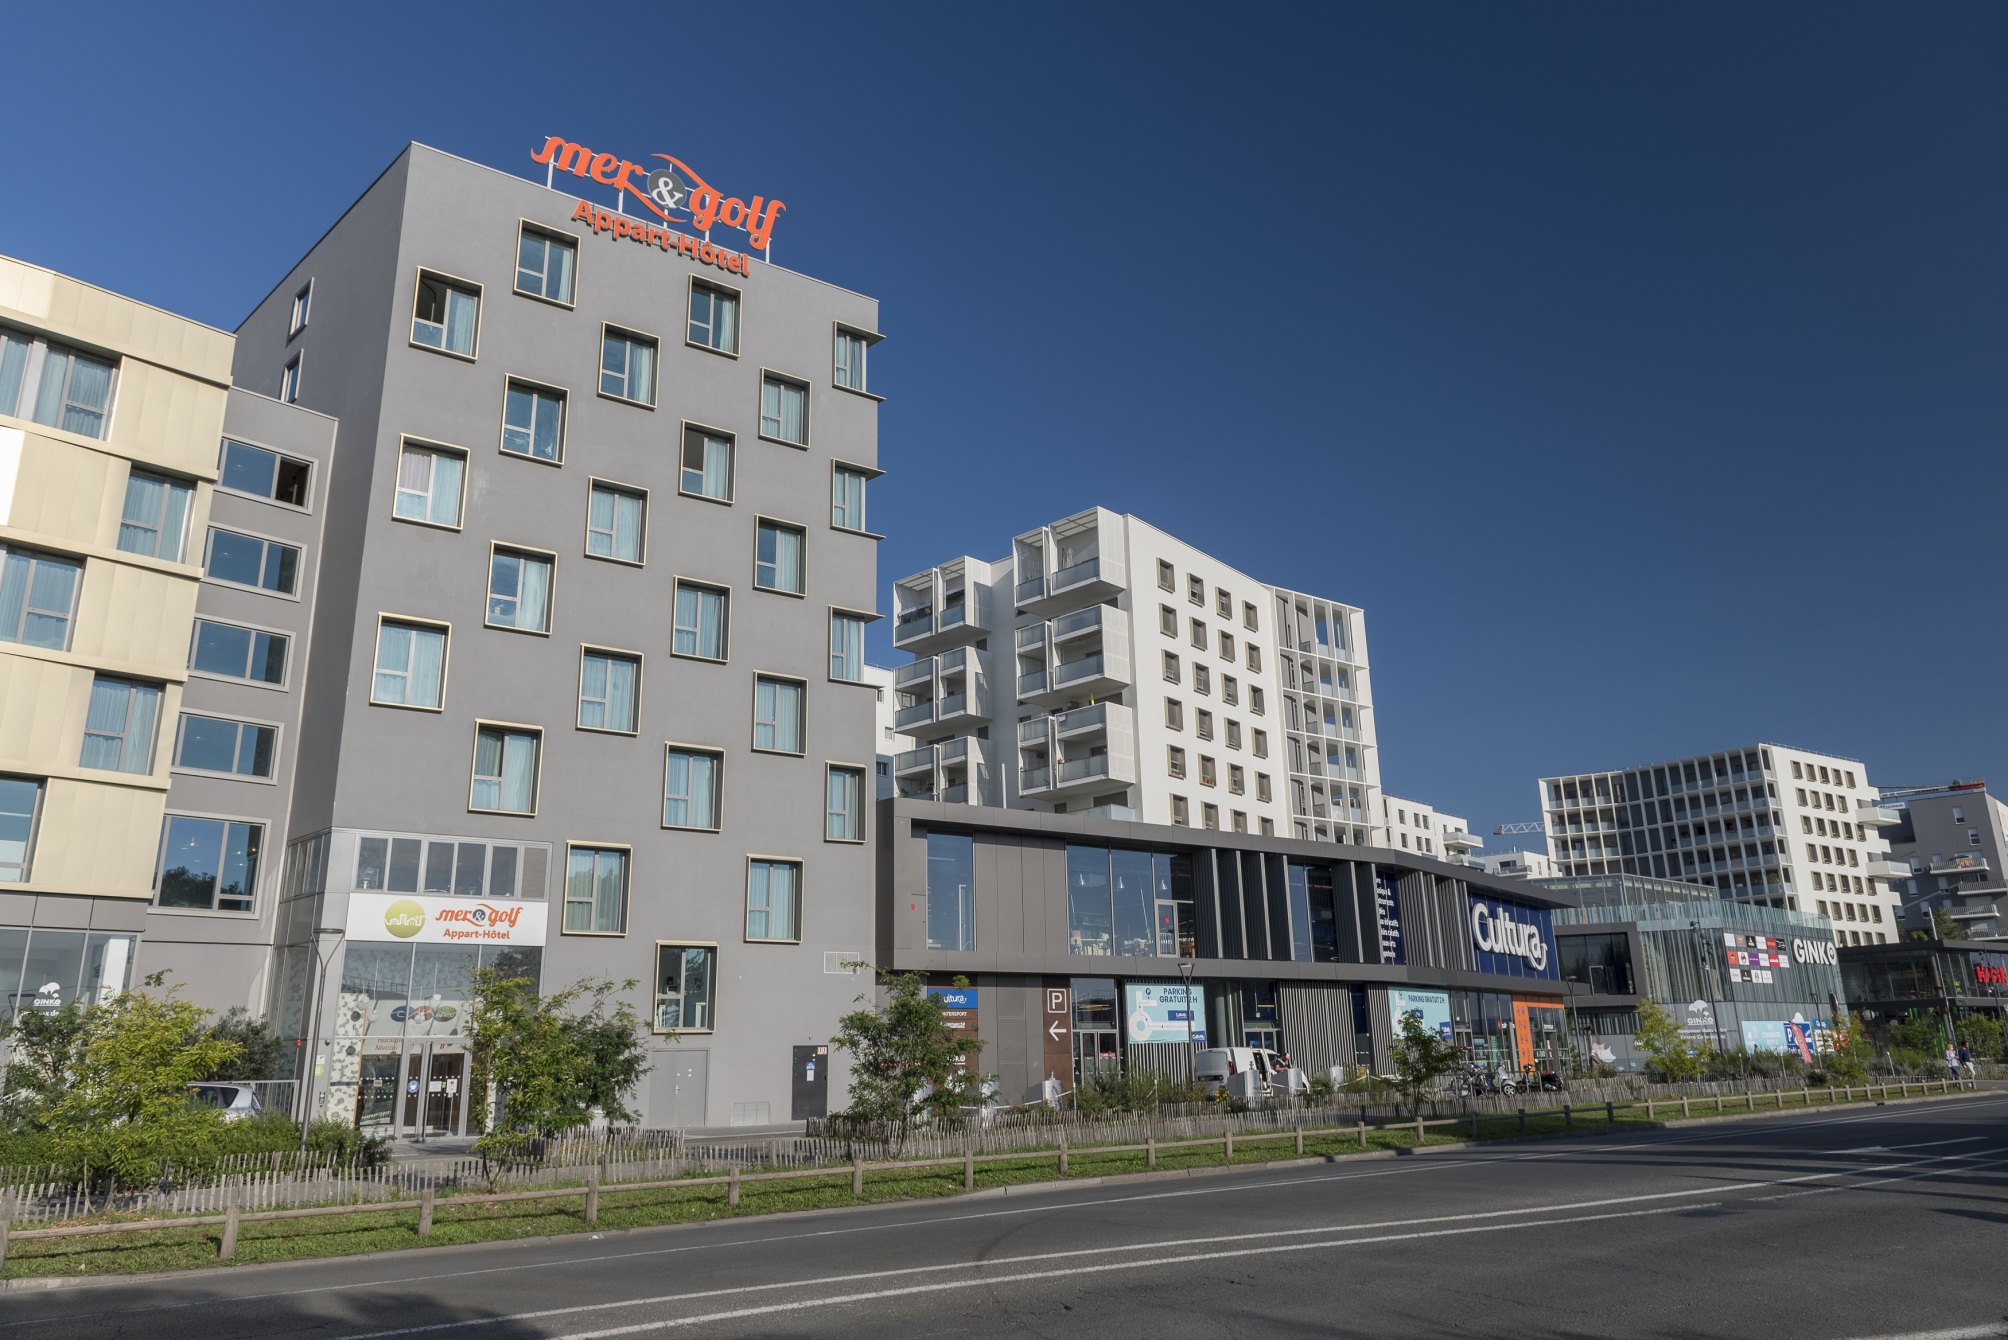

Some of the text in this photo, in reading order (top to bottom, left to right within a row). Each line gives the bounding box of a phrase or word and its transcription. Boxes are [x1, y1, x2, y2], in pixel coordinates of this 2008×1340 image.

[571, 199, 751, 277] Appart-Hôtel
[443, 928, 511, 940] Appart-Hôtel
[1472, 902, 1548, 971] Cultura
[1793, 938, 1837, 966] GINKO
[33, 998, 61, 1006] GINKO
[943, 993, 967, 1004] ultura
